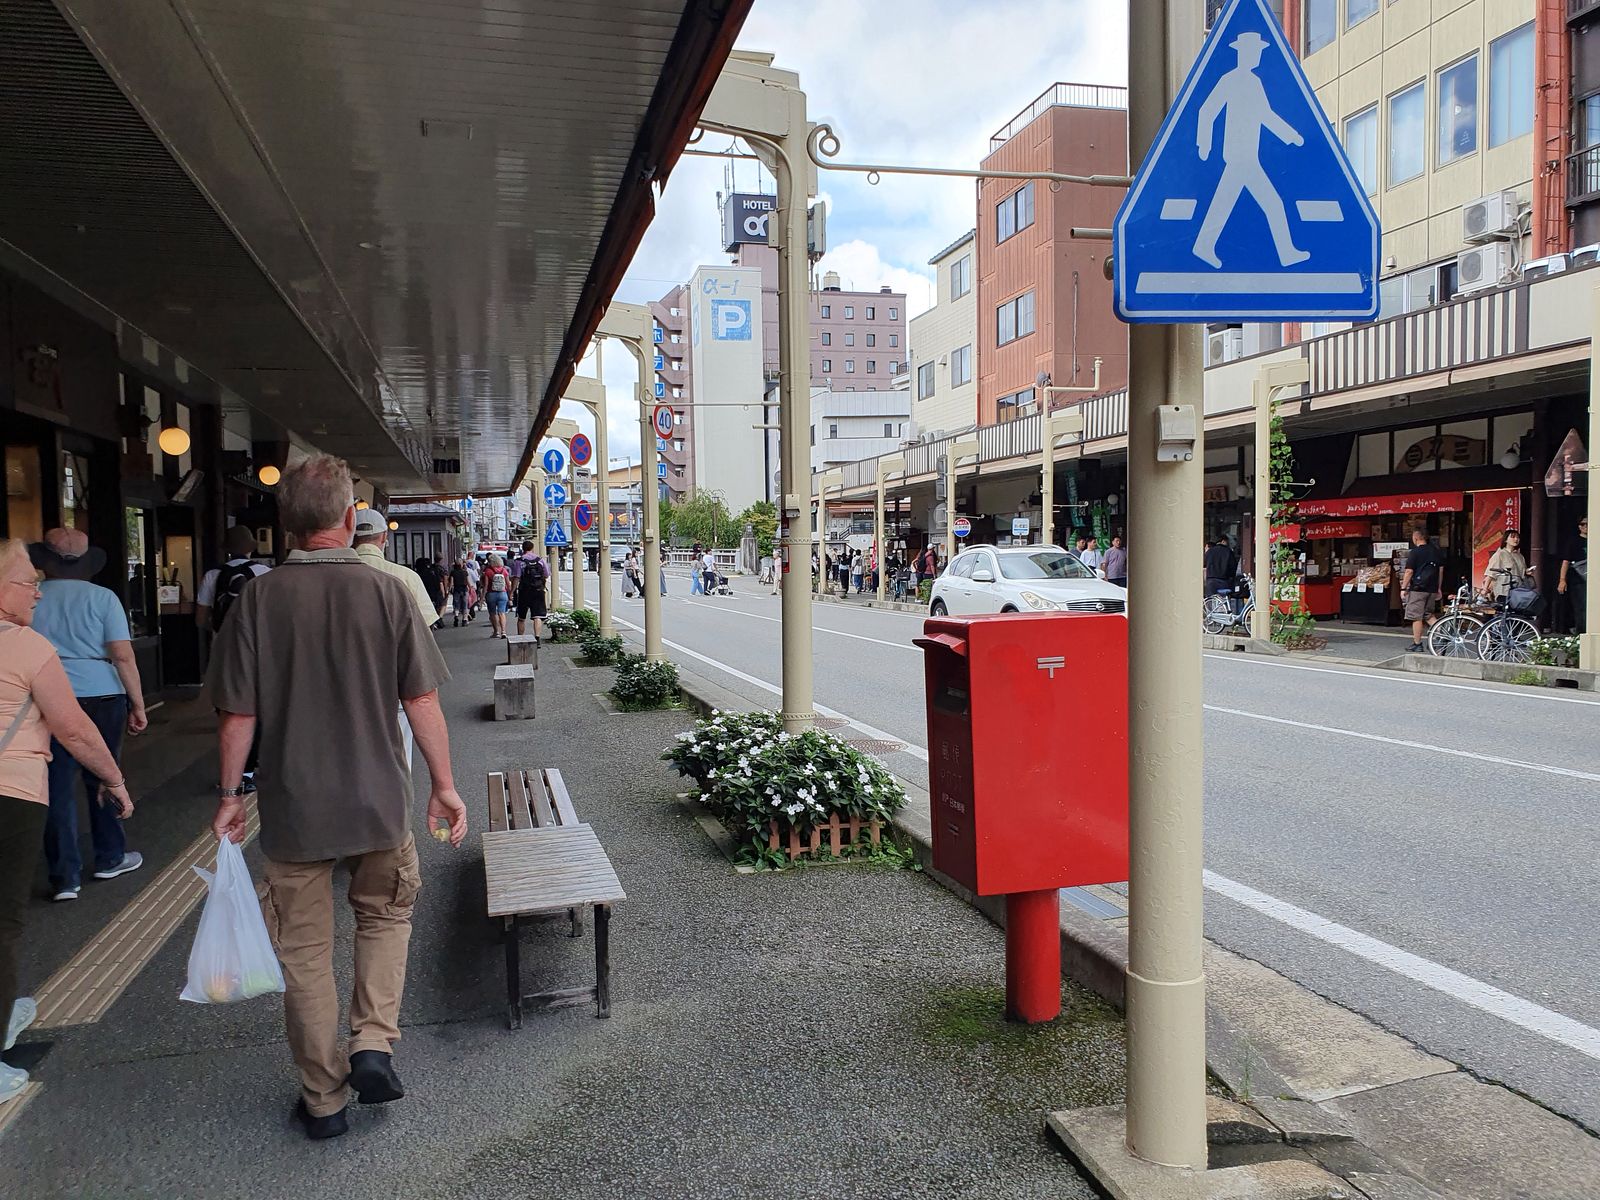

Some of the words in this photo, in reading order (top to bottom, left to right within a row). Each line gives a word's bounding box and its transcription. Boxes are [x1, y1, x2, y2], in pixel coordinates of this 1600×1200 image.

[743, 200, 774, 210] HOTEL
[718, 305, 747, 337] P
[658, 411, 671, 430] 40
